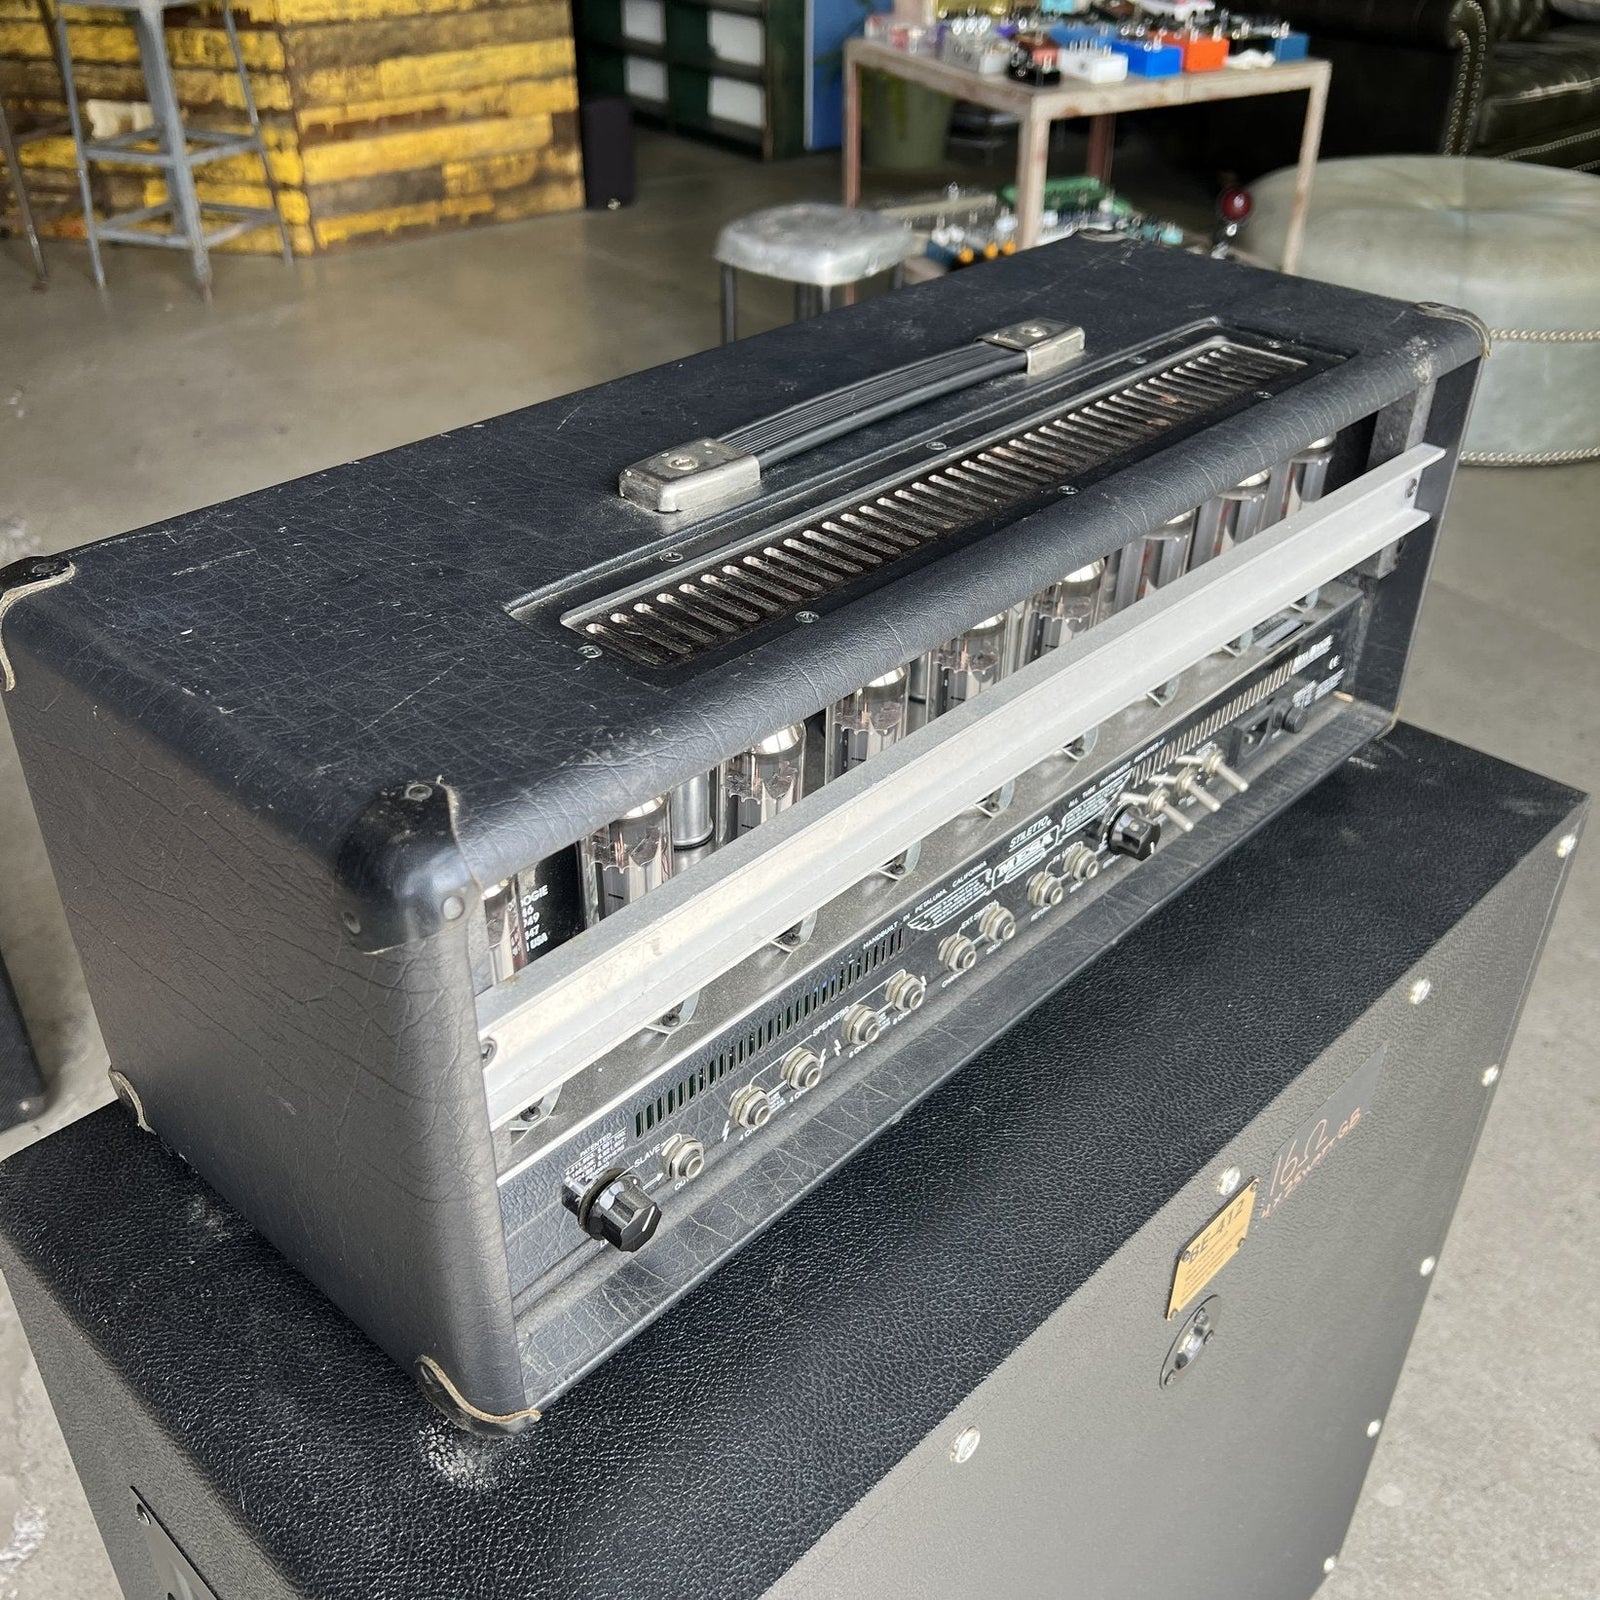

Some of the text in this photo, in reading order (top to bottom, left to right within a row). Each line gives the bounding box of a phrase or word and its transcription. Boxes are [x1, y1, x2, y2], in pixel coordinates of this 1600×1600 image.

[1009, 815, 1049, 848] STILETTO
[863, 921, 898, 949] HANDBUILT
[915, 888, 947, 913] PETALUMA
[952, 860, 987, 888] CALIFORNIA
[812, 1005, 850, 1037] SPEAKERS
[634, 1143, 661, 1168] SLAVE
